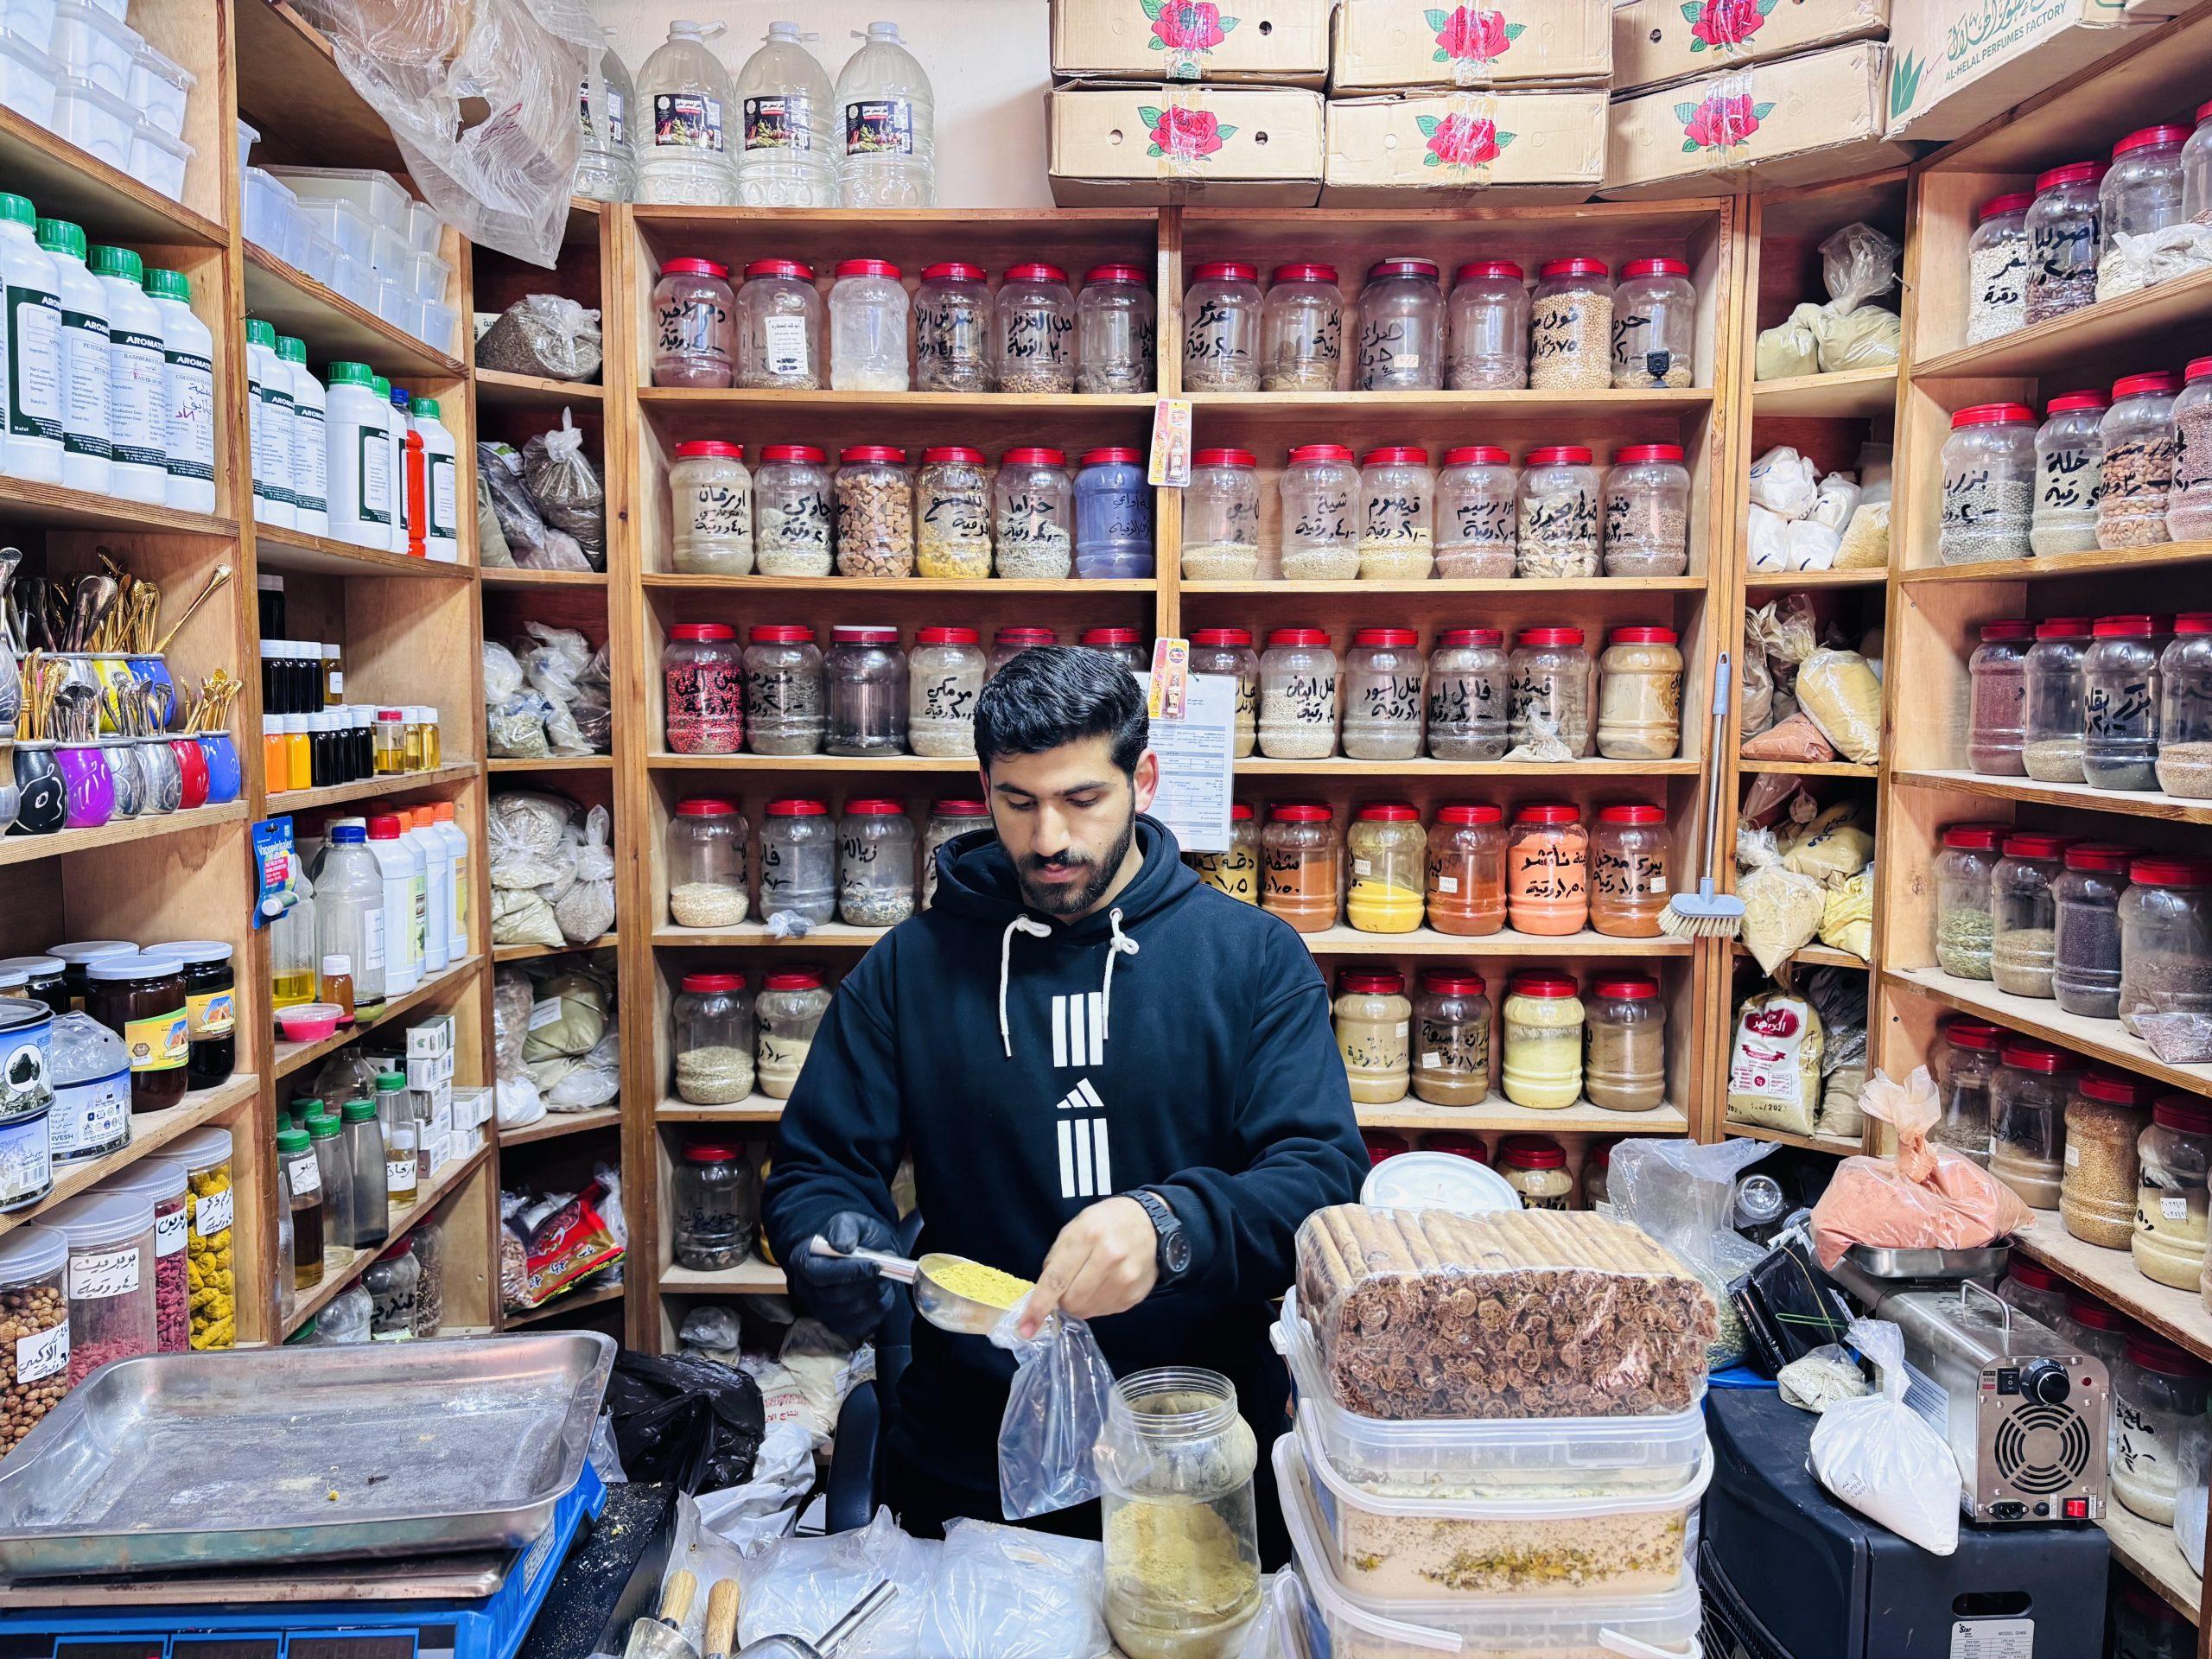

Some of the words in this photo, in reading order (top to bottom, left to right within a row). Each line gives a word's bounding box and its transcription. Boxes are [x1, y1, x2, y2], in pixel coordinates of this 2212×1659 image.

[1945, 54, 1981, 83] AL-HELAL
[1982, 27, 2024, 60] PERFUMES
[2026, 0, 2067, 35] FACTORY
